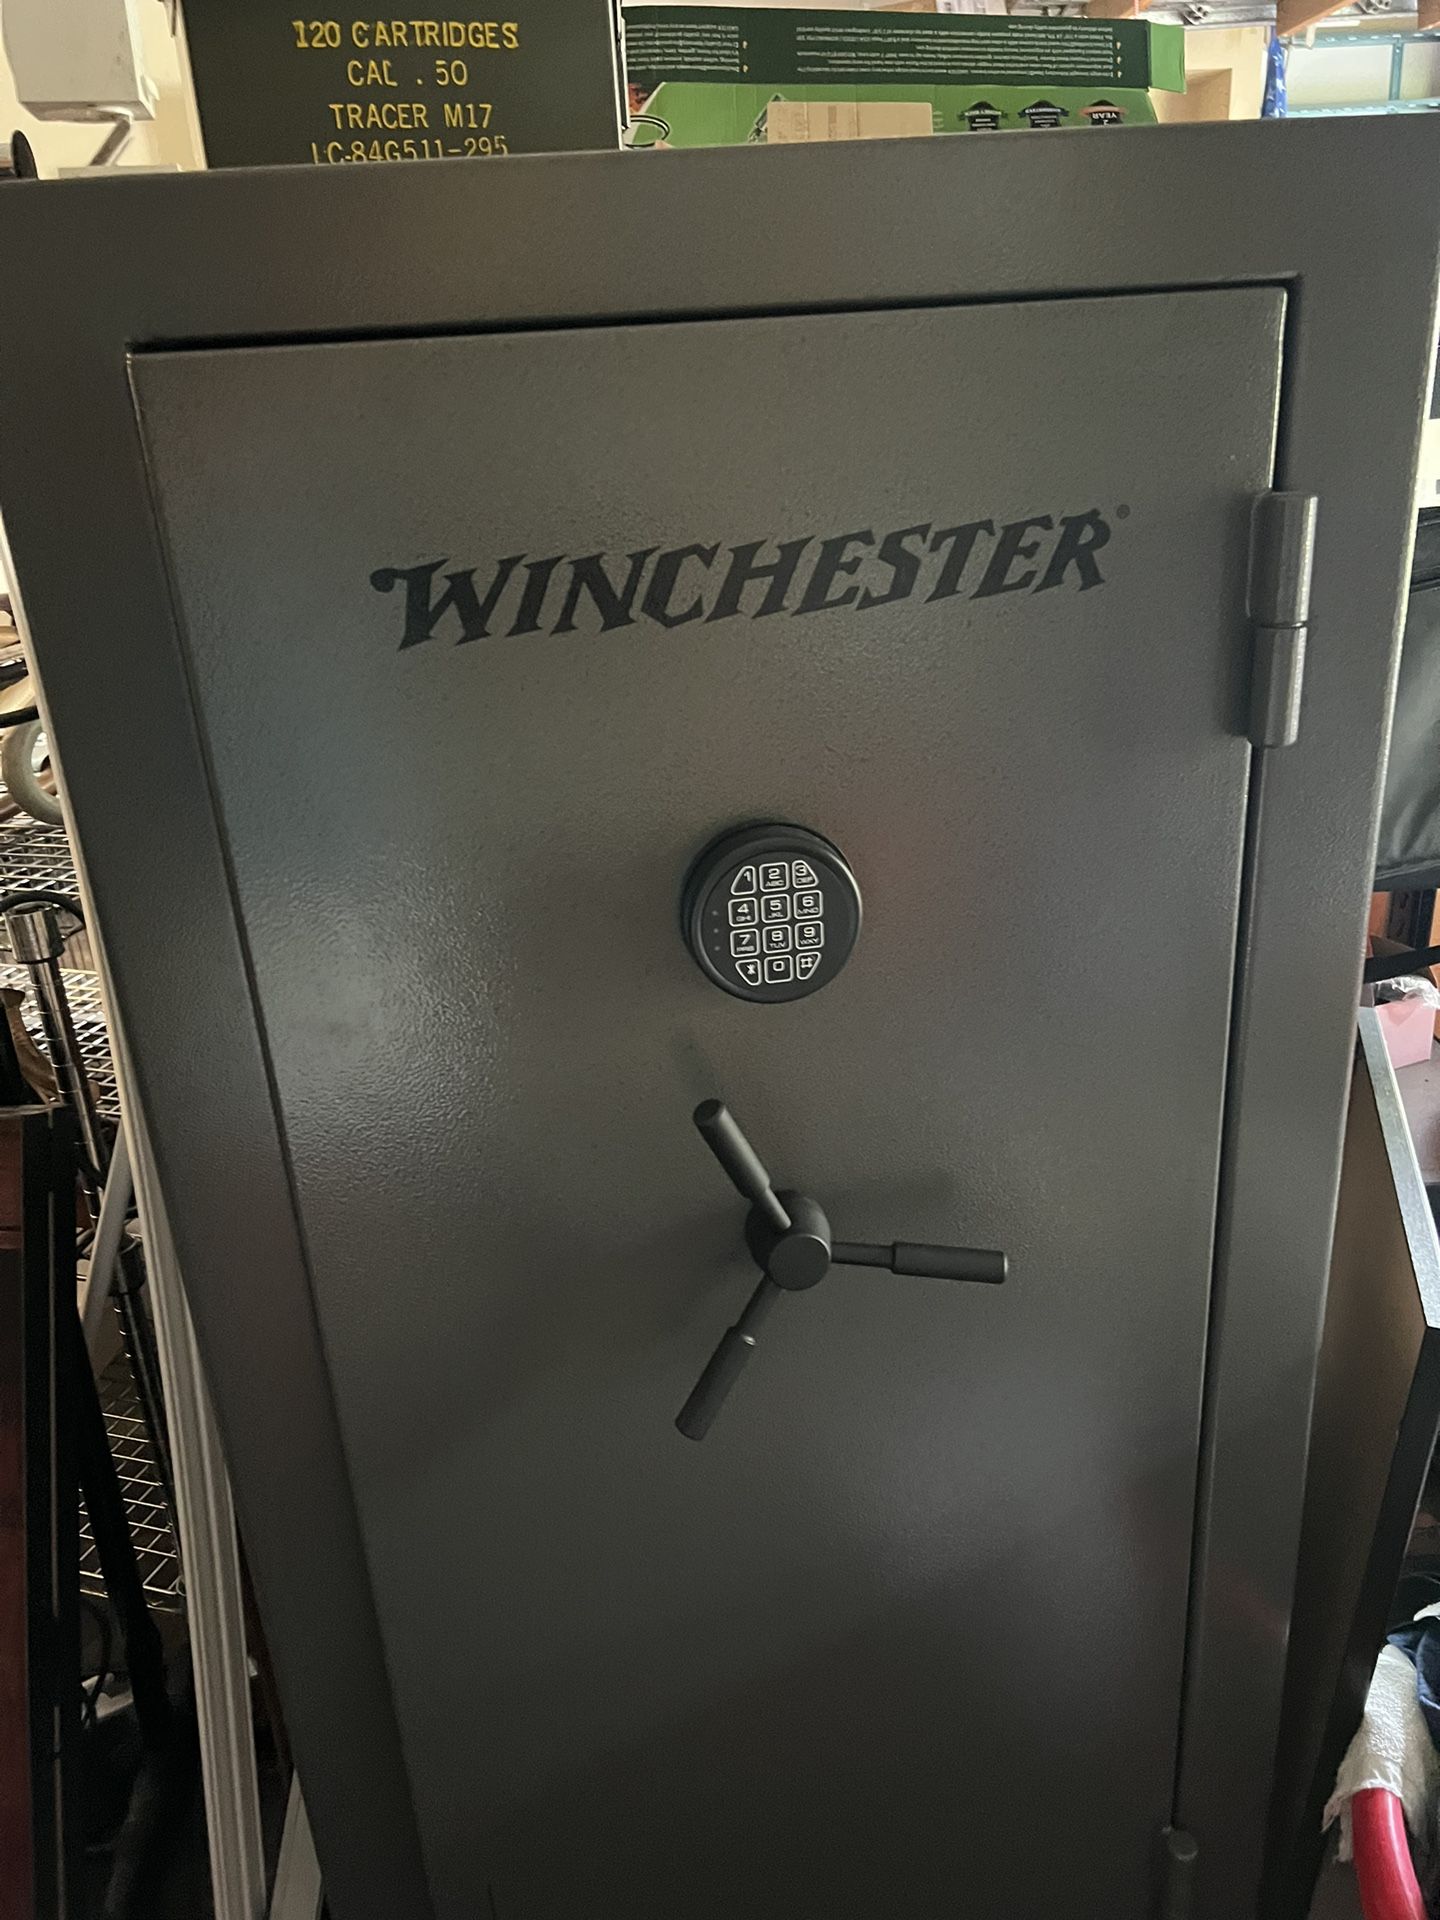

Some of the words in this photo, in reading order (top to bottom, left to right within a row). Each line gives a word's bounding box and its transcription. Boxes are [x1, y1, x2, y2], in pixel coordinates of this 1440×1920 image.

[293, 20, 341, 48] 120
[352, 20, 519, 48] CARTRIDGES
[329, 103, 429, 129] TRACER
[444, 103, 493, 129] M17
[369, 508, 1111, 652] WINCHESTER
[768, 868, 781, 879] 2
[795, 865, 807, 876] 3
[744, 871, 751, 882] 1
[769, 900, 782, 911] 5
[802, 896, 815, 907] 6
[737, 903, 750, 914] 4
[771, 930, 784, 941] 8
[803, 927, 815, 938] 9
[739, 934, 751, 945] 7
[772, 961, 785, 972] 0
